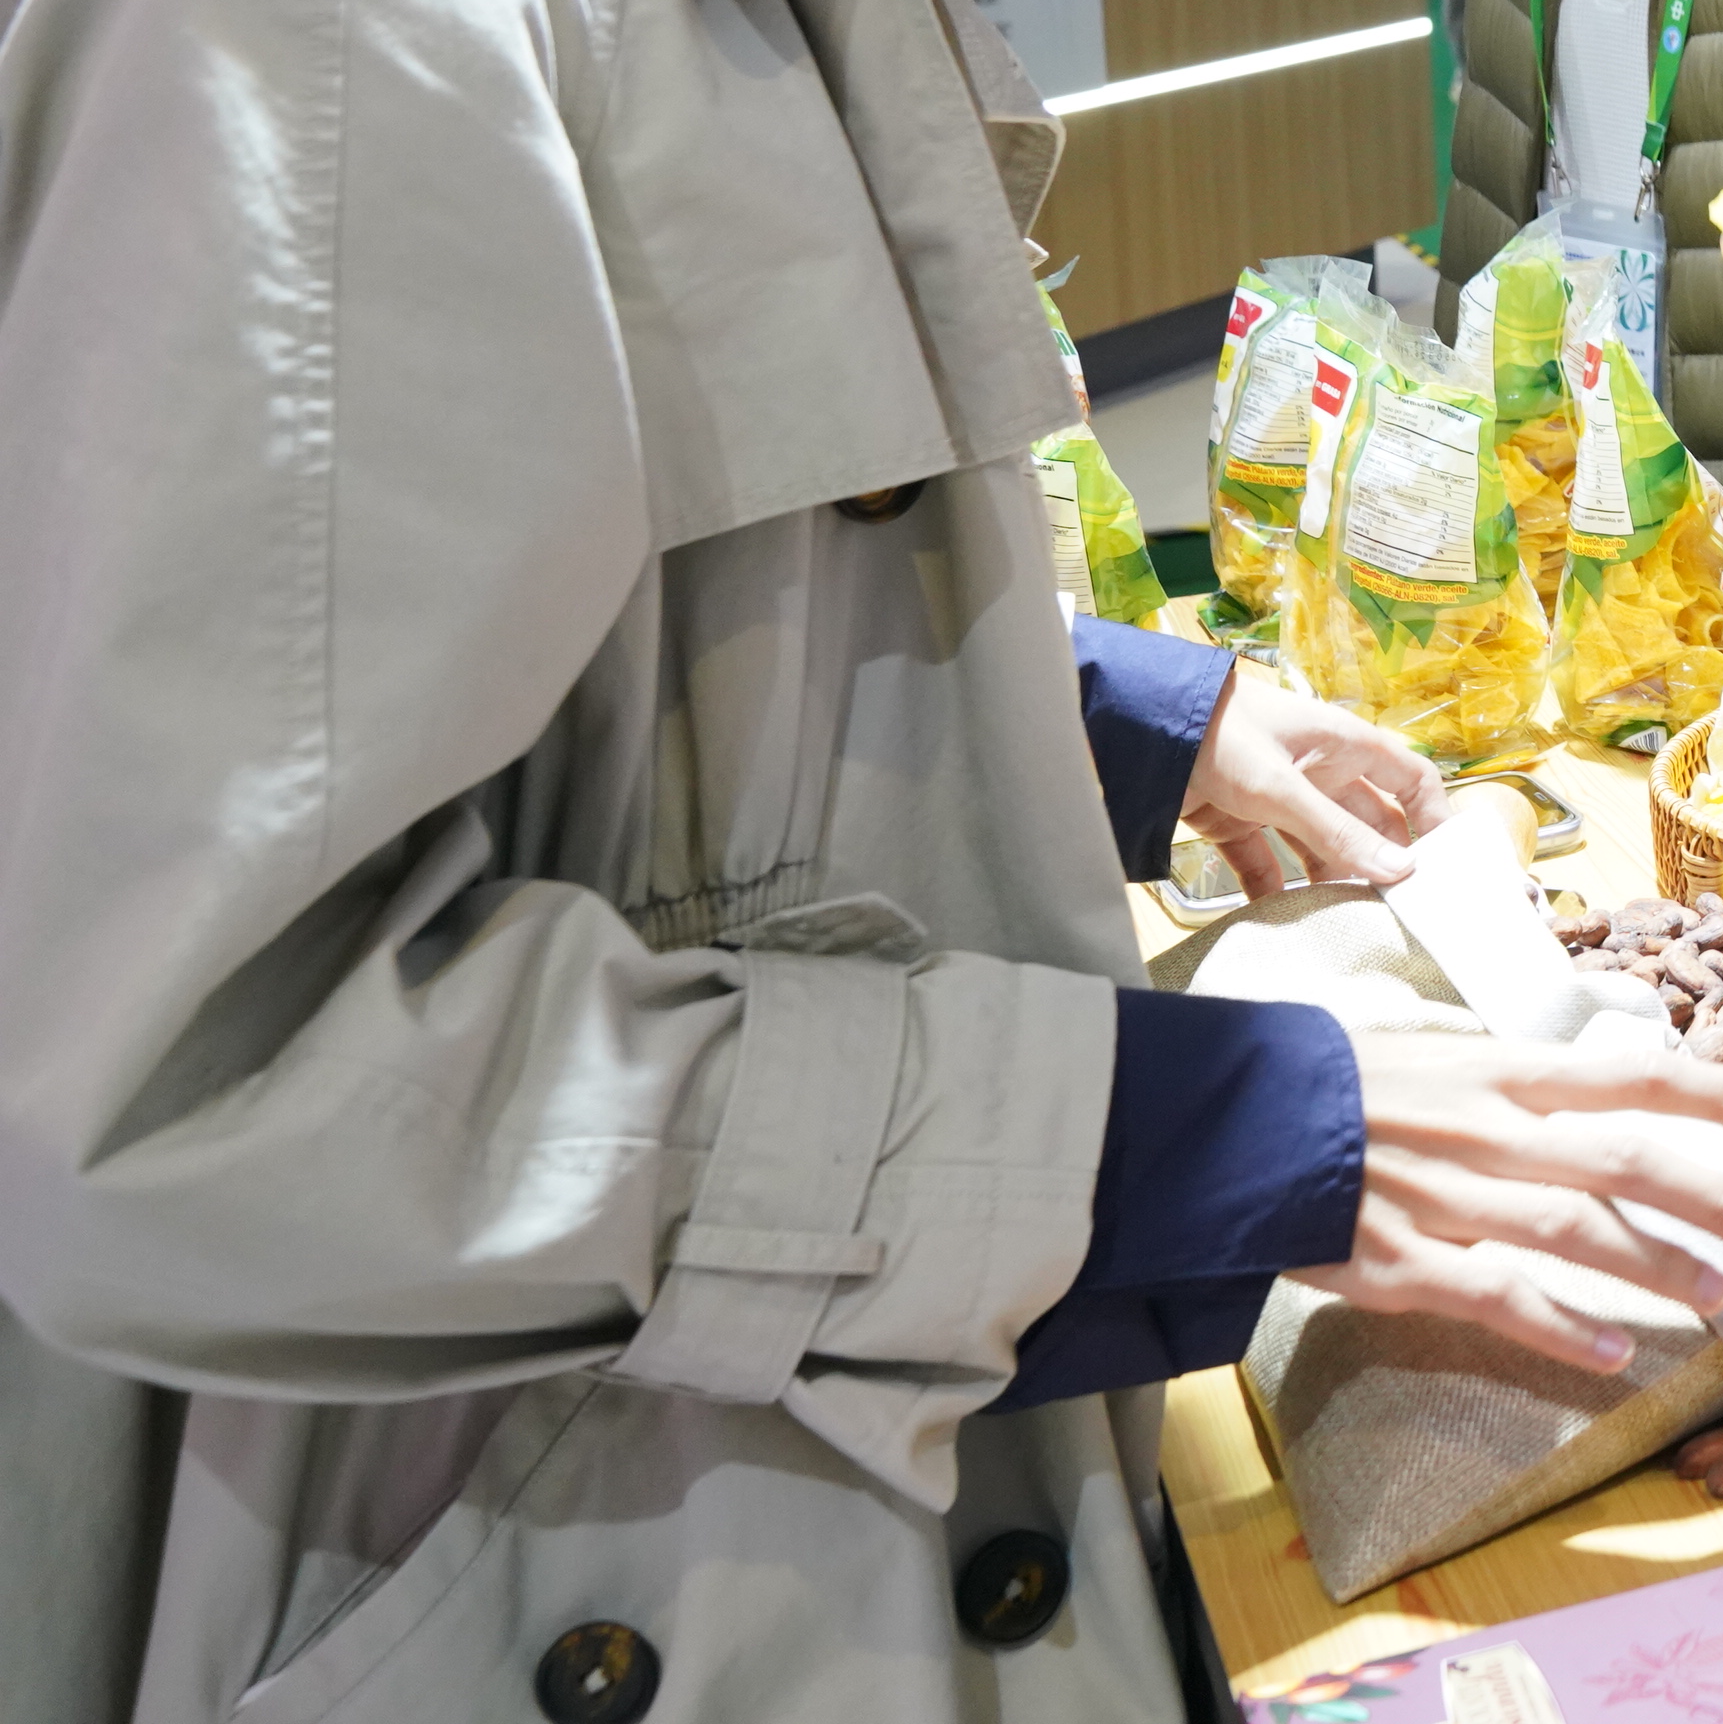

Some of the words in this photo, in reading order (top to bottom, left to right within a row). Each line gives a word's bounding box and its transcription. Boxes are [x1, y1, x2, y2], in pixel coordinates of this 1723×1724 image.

[1603, 539, 1626, 548] aceite
[1412, 585, 1439, 594] verde,
[1441, 585, 1467, 594] aceite
